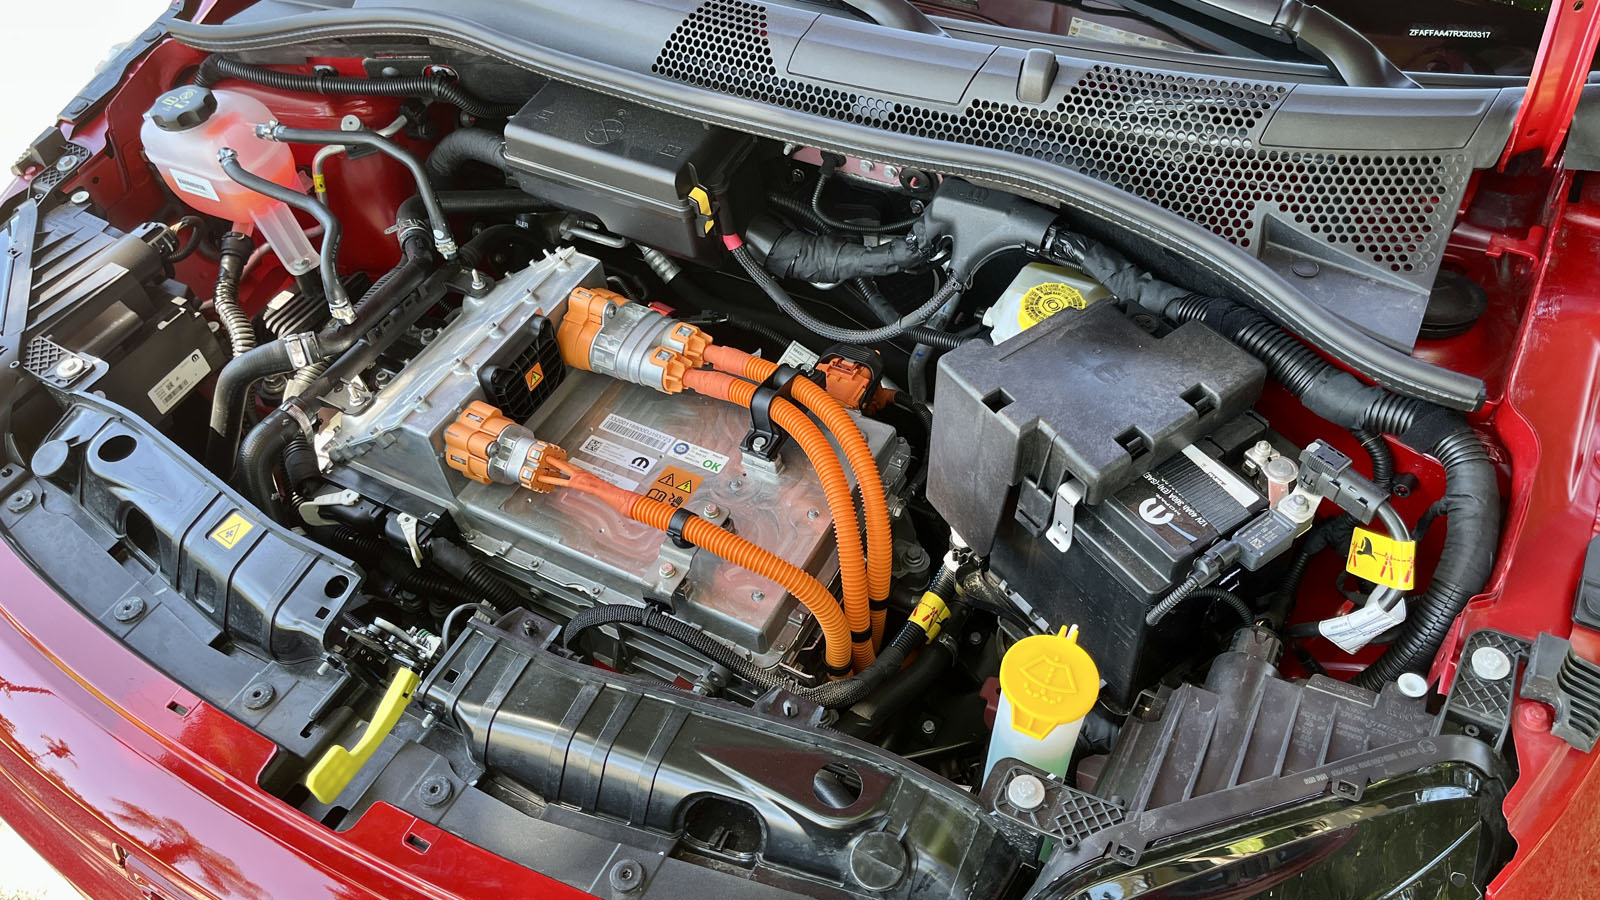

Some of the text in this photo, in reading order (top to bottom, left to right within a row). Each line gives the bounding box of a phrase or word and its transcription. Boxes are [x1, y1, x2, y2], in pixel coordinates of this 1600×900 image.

[1409, 29, 1491, 38] ZFAFFAA47RX203317
[702, 459, 722, 472] OK
[1182, 504, 1198, 518] 40Ah
[1194, 516, 1208, 527] 12V
